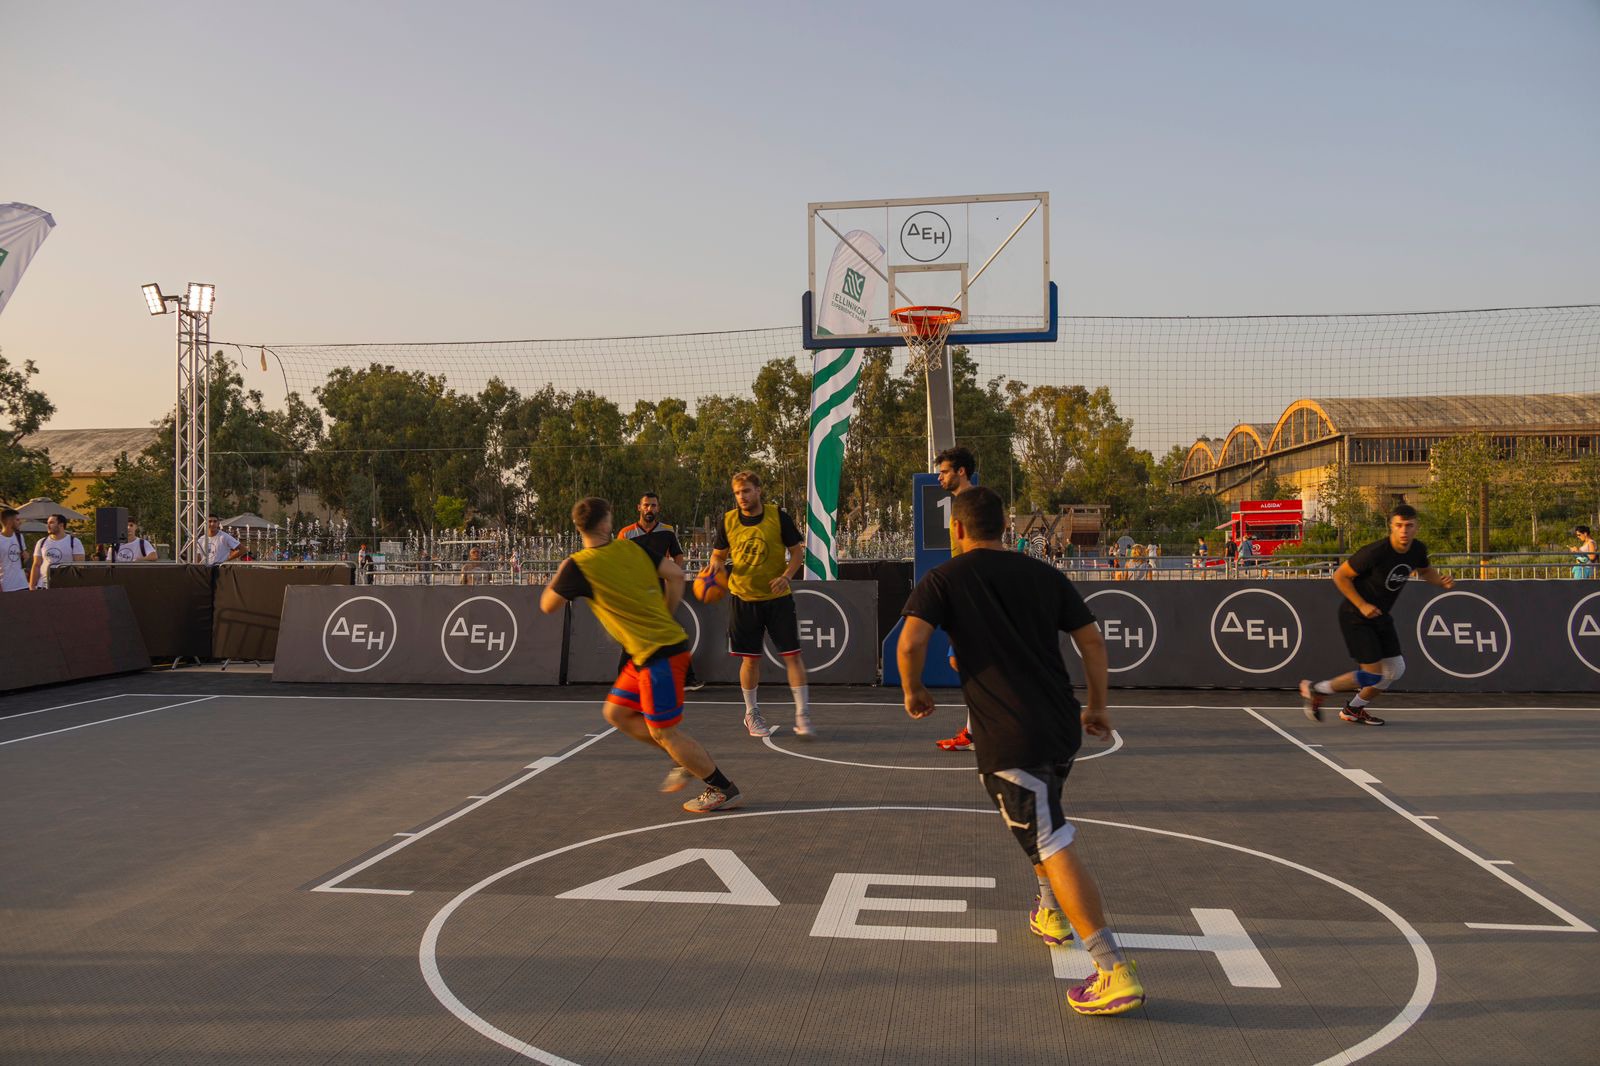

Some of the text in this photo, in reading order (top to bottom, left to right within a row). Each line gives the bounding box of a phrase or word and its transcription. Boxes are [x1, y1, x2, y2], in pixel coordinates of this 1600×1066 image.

[907, 223, 945, 245] ΔΕΗ
[331, 617, 385, 650] ΔΕΗ
[449, 617, 505, 651] ΔΕΗ
[797, 620, 835, 648] ΕΗ
[1094, 618, 1144, 648] ΕΗ
[1220, 612, 1288, 649] ΔΕΗ
[1427, 615, 1498, 653] ΔΕΗ
[554, 848, 1282, 990] ΔΕΗ
